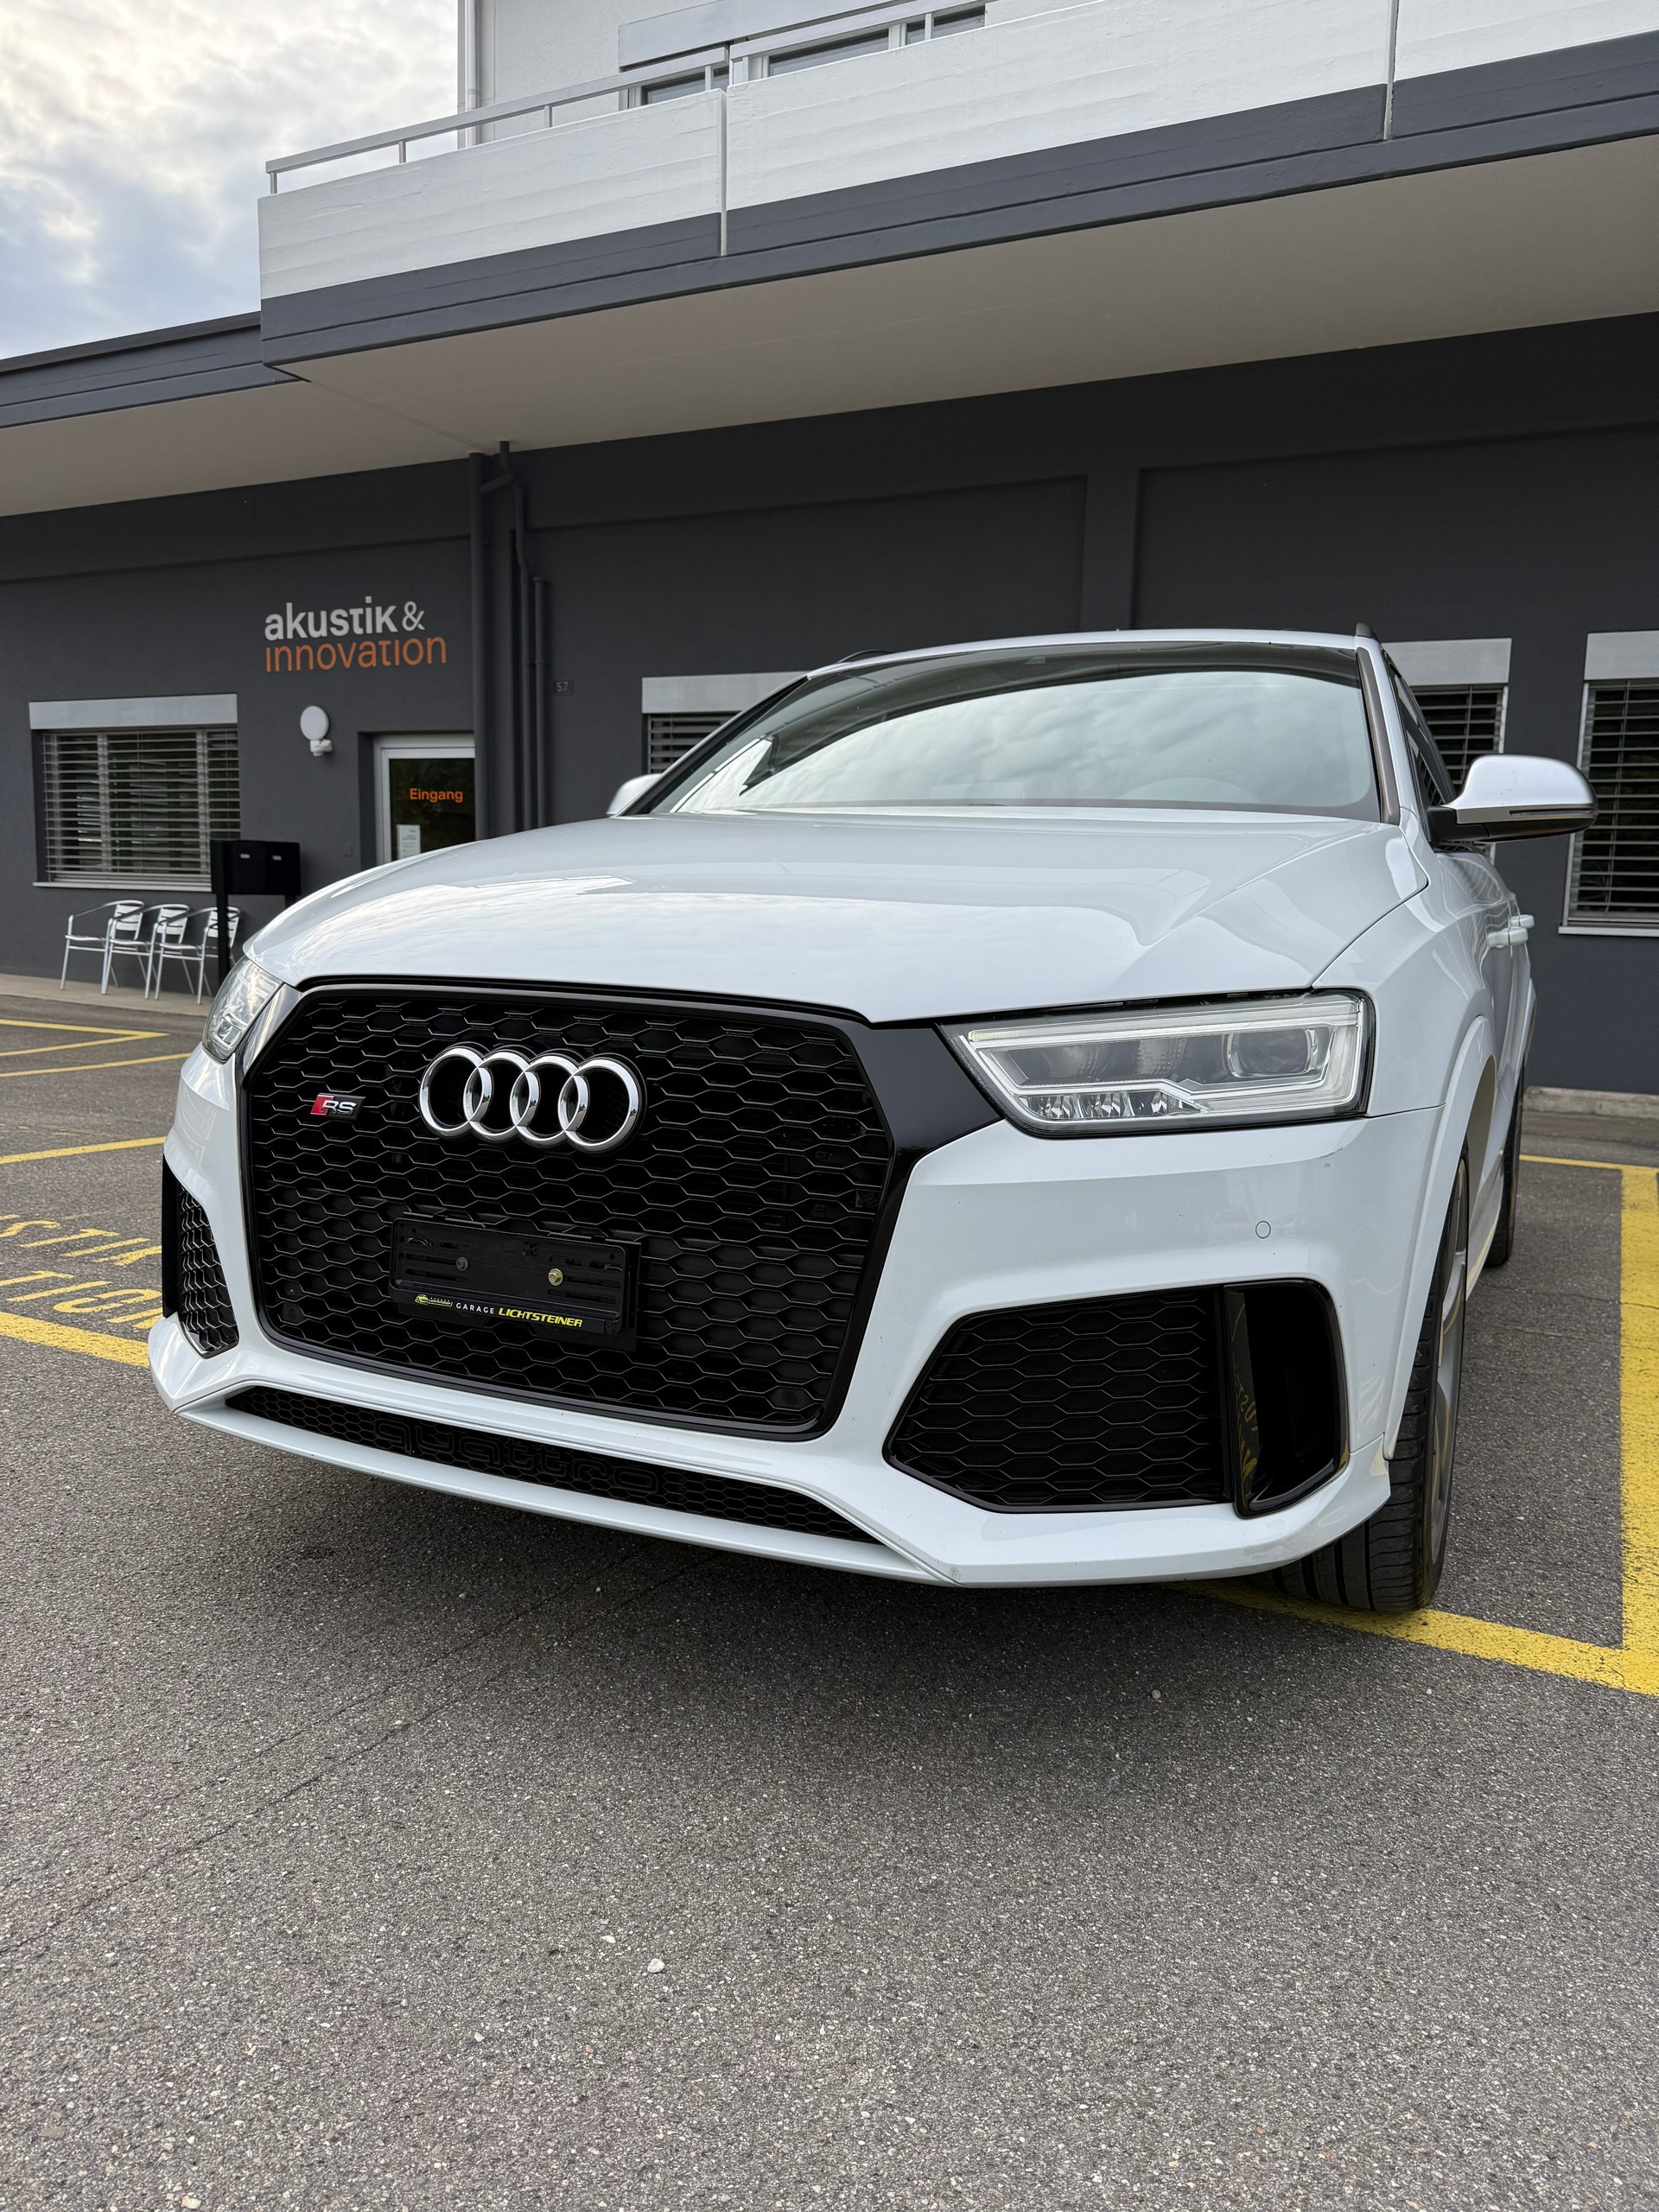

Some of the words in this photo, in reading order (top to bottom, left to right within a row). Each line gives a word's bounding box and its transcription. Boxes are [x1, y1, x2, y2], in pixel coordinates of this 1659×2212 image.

[264, 595, 398, 641] akustik
[402, 601, 426, 632] &
[265, 636, 448, 673] innovation
[556, 681, 569, 693] 57
[409, 788, 464, 804] Eingang
[321, 1099, 357, 1116] RS
[455, 1302, 495, 1314] GARAGE
[498, 1307, 583, 1327] LICHTSTEINER
[373, 1417, 661, 1496] quattro
